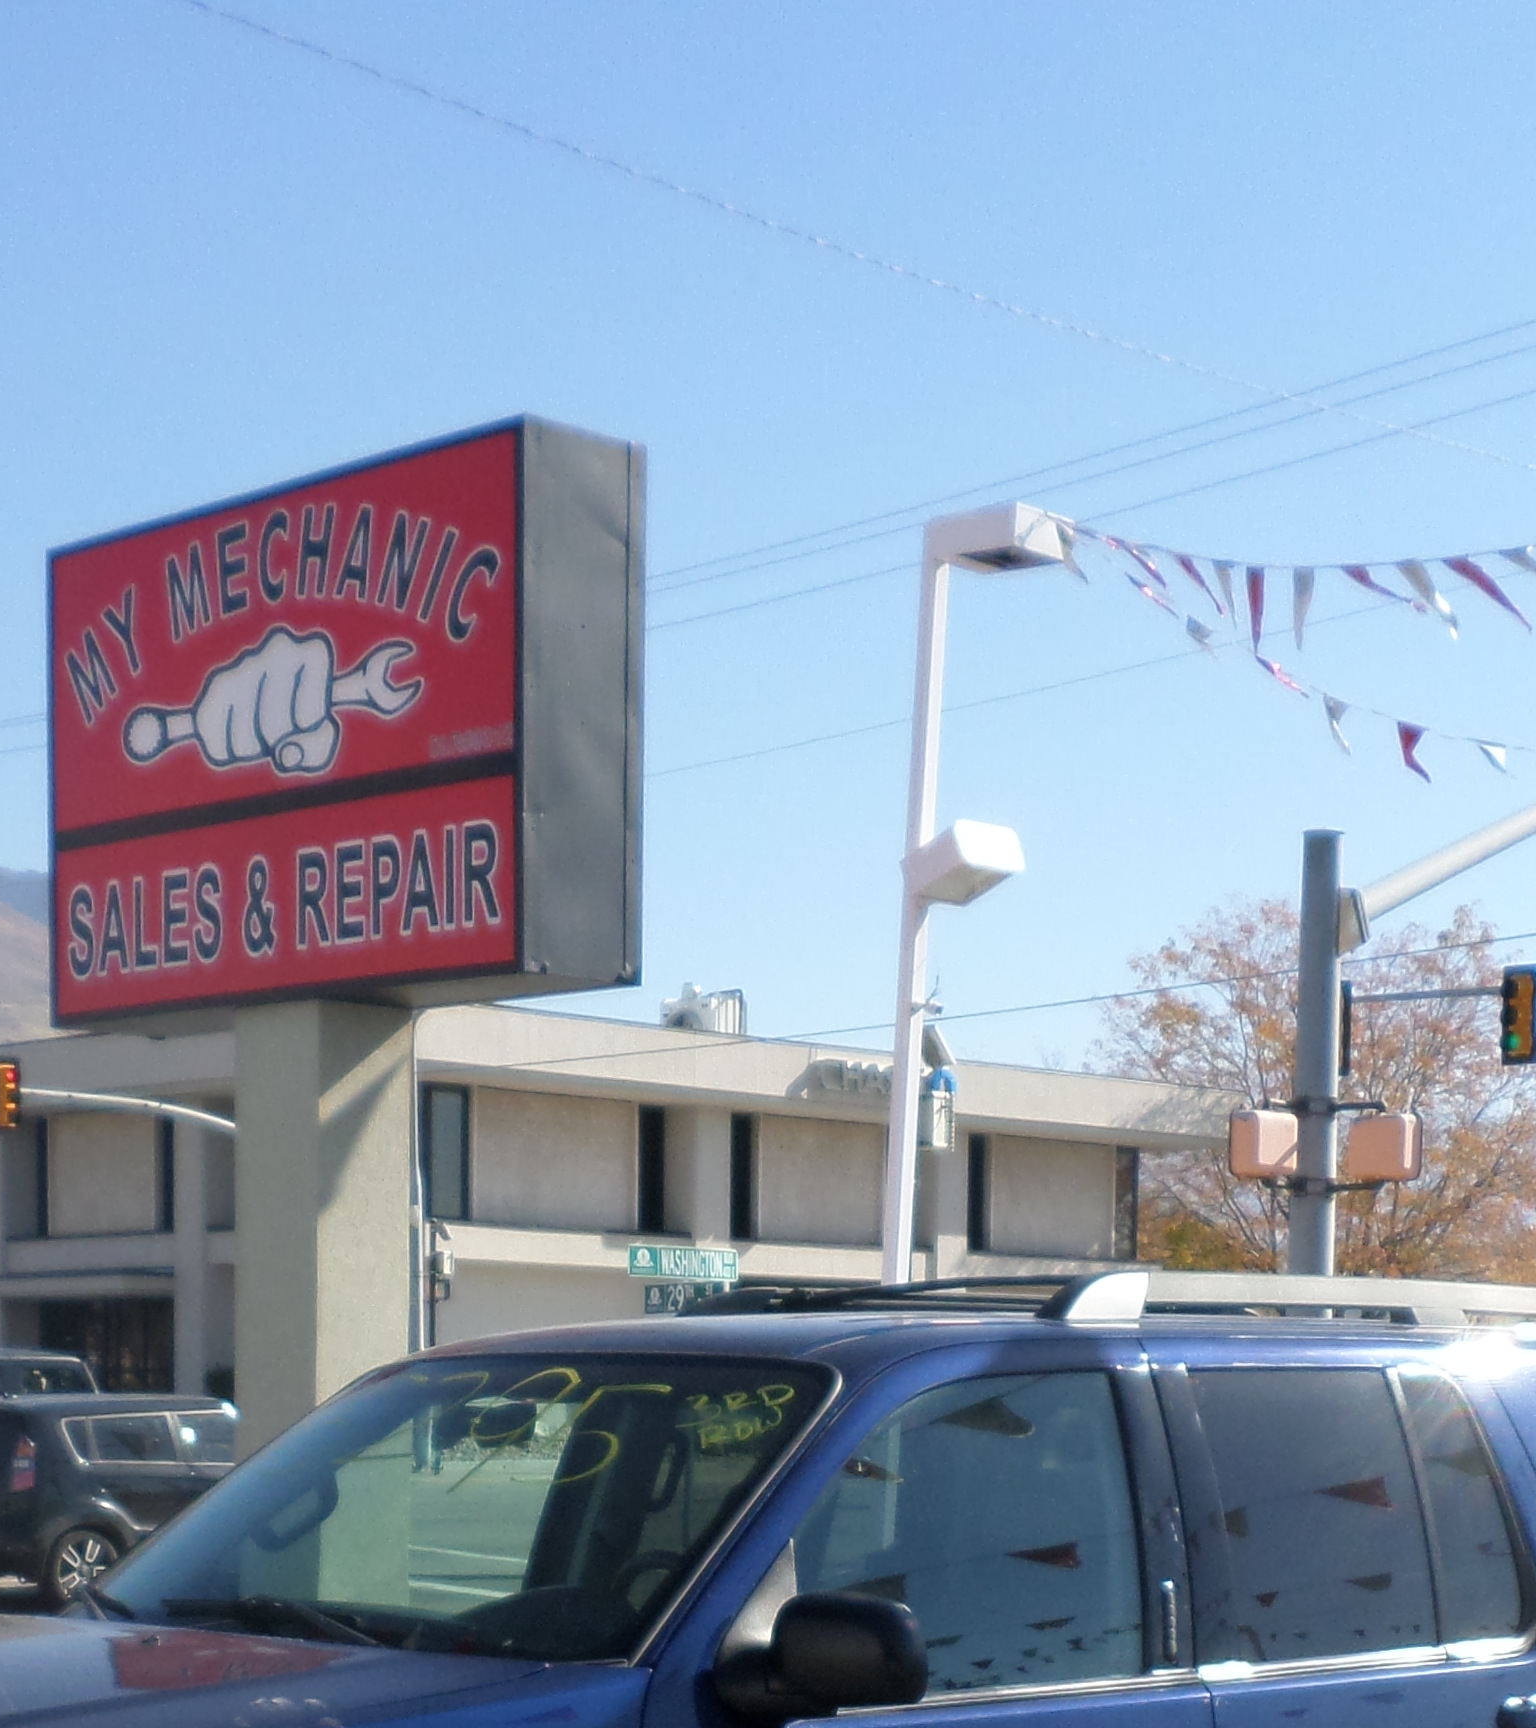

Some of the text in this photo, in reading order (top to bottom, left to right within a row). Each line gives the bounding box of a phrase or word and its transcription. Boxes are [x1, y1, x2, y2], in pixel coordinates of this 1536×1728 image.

[64, 500, 501, 725] MY MECHANIC
[66, 818, 503, 981] SALES & REPAIR
[661, 1248, 723, 1278] WASHINGTON
[675, 1385, 795, 1428] 3RD
[697, 1406, 782, 1448] ROW
